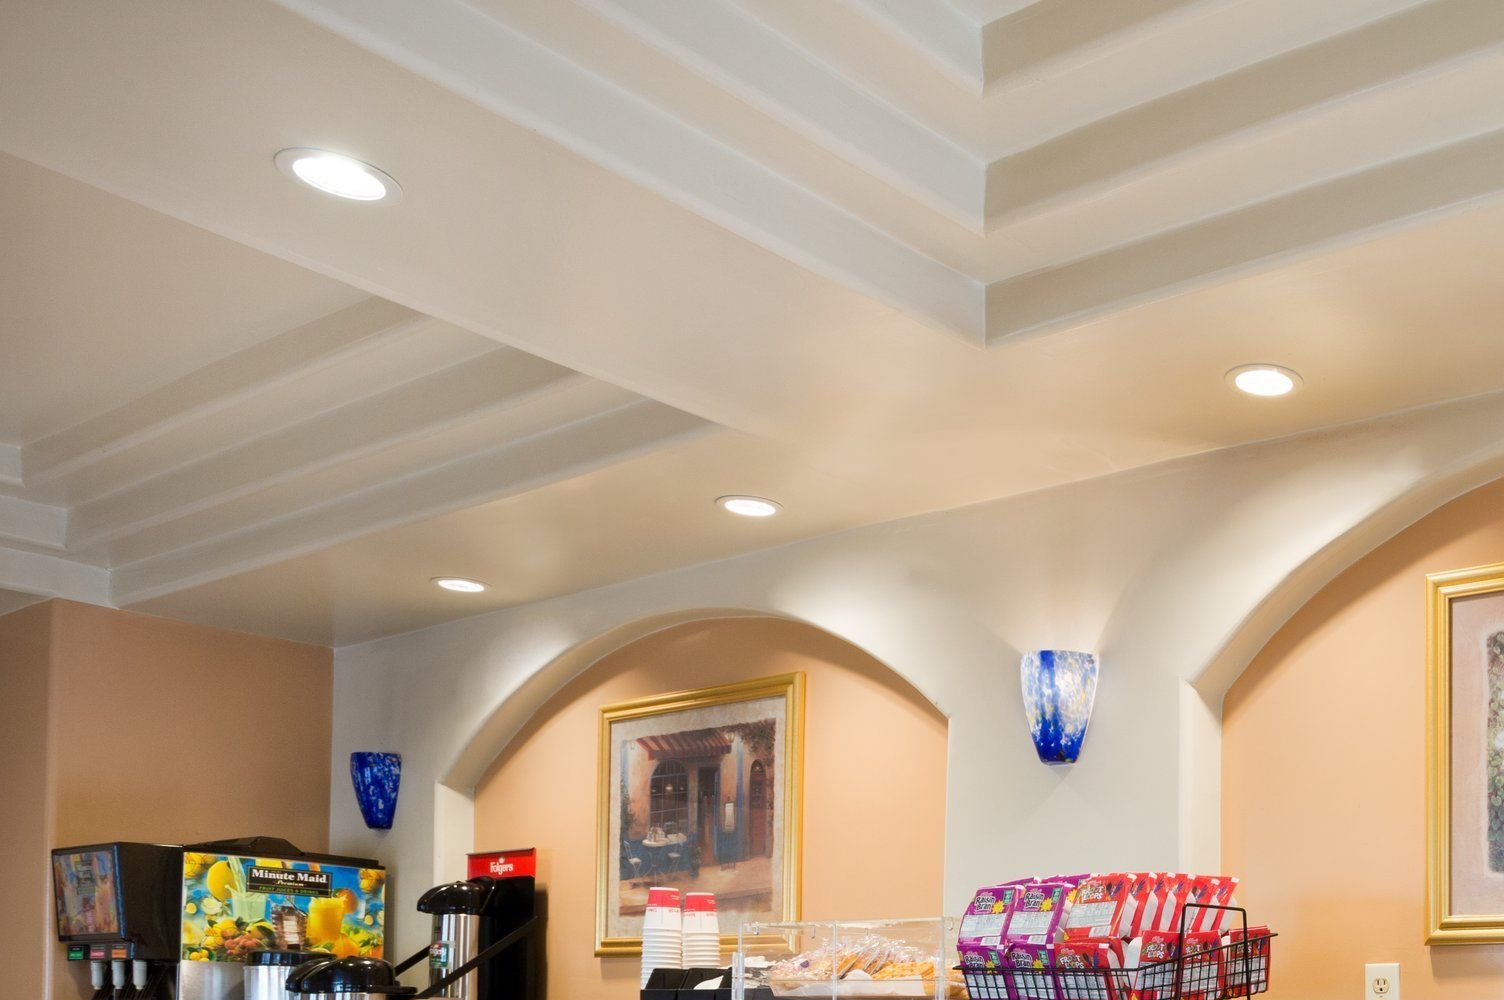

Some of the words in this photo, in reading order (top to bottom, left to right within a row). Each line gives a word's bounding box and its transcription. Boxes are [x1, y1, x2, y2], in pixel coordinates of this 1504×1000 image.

[490, 861, 513, 875] Folgers
[252, 868, 295, 881] Minute
[297, 872, 327, 883] Maid
